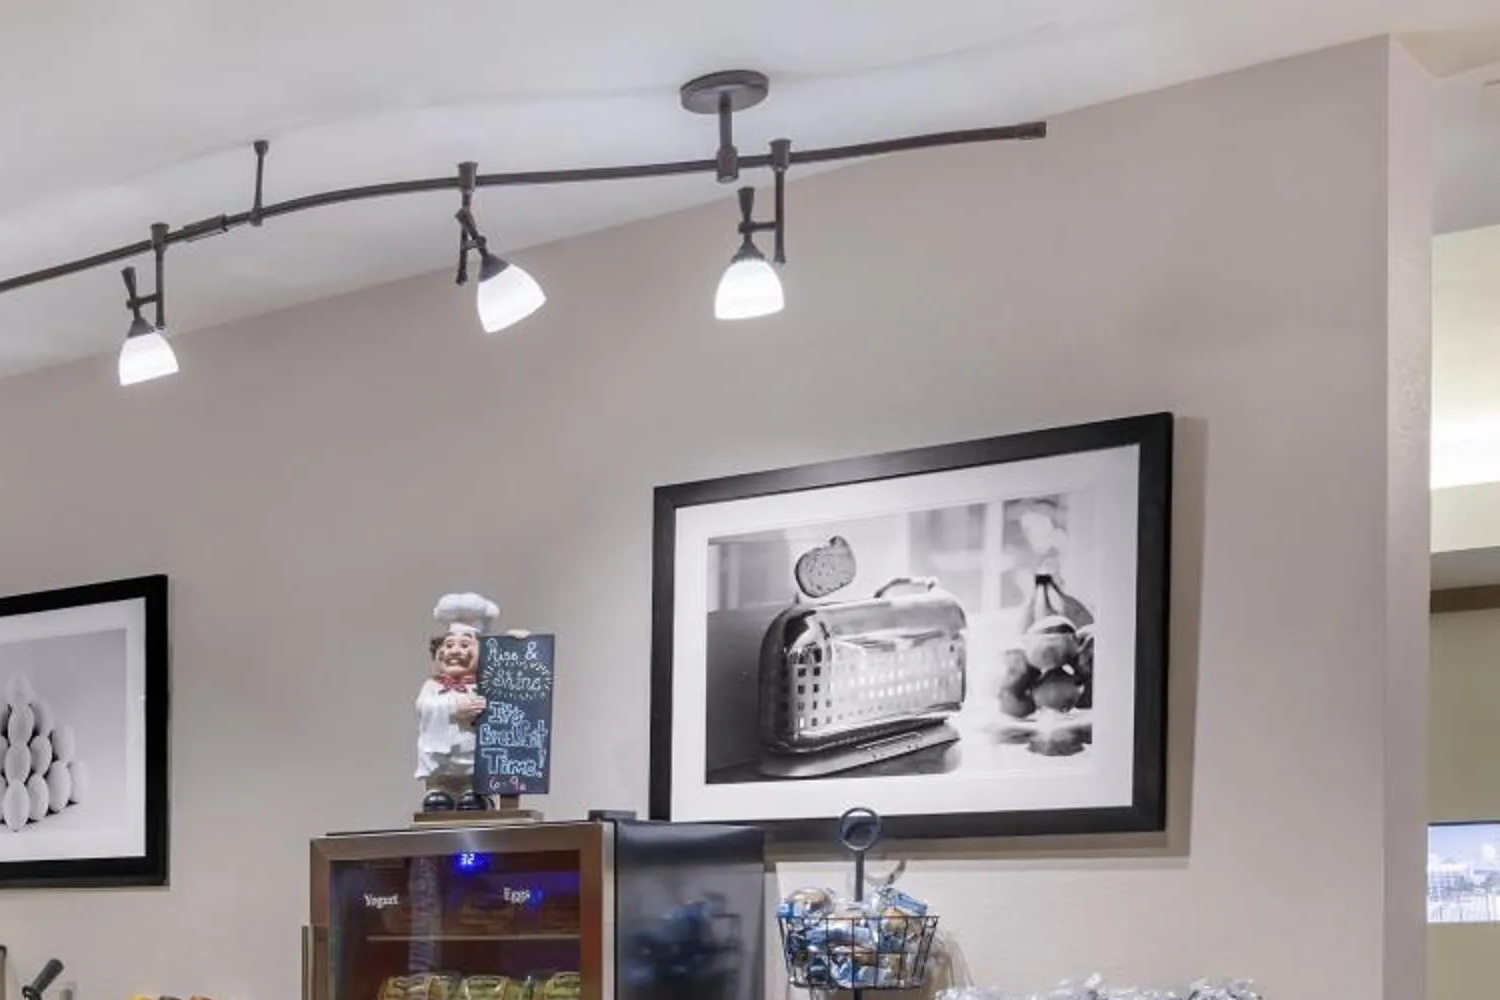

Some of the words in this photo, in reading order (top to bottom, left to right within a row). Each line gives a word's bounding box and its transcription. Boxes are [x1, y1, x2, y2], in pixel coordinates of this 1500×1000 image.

[486, 638, 518, 662] Rise
[526, 641, 537, 660] &
[481, 748, 547, 777] Time!
[460, 853, 475, 865] 32
[364, 894, 399, 909] Yogurt
